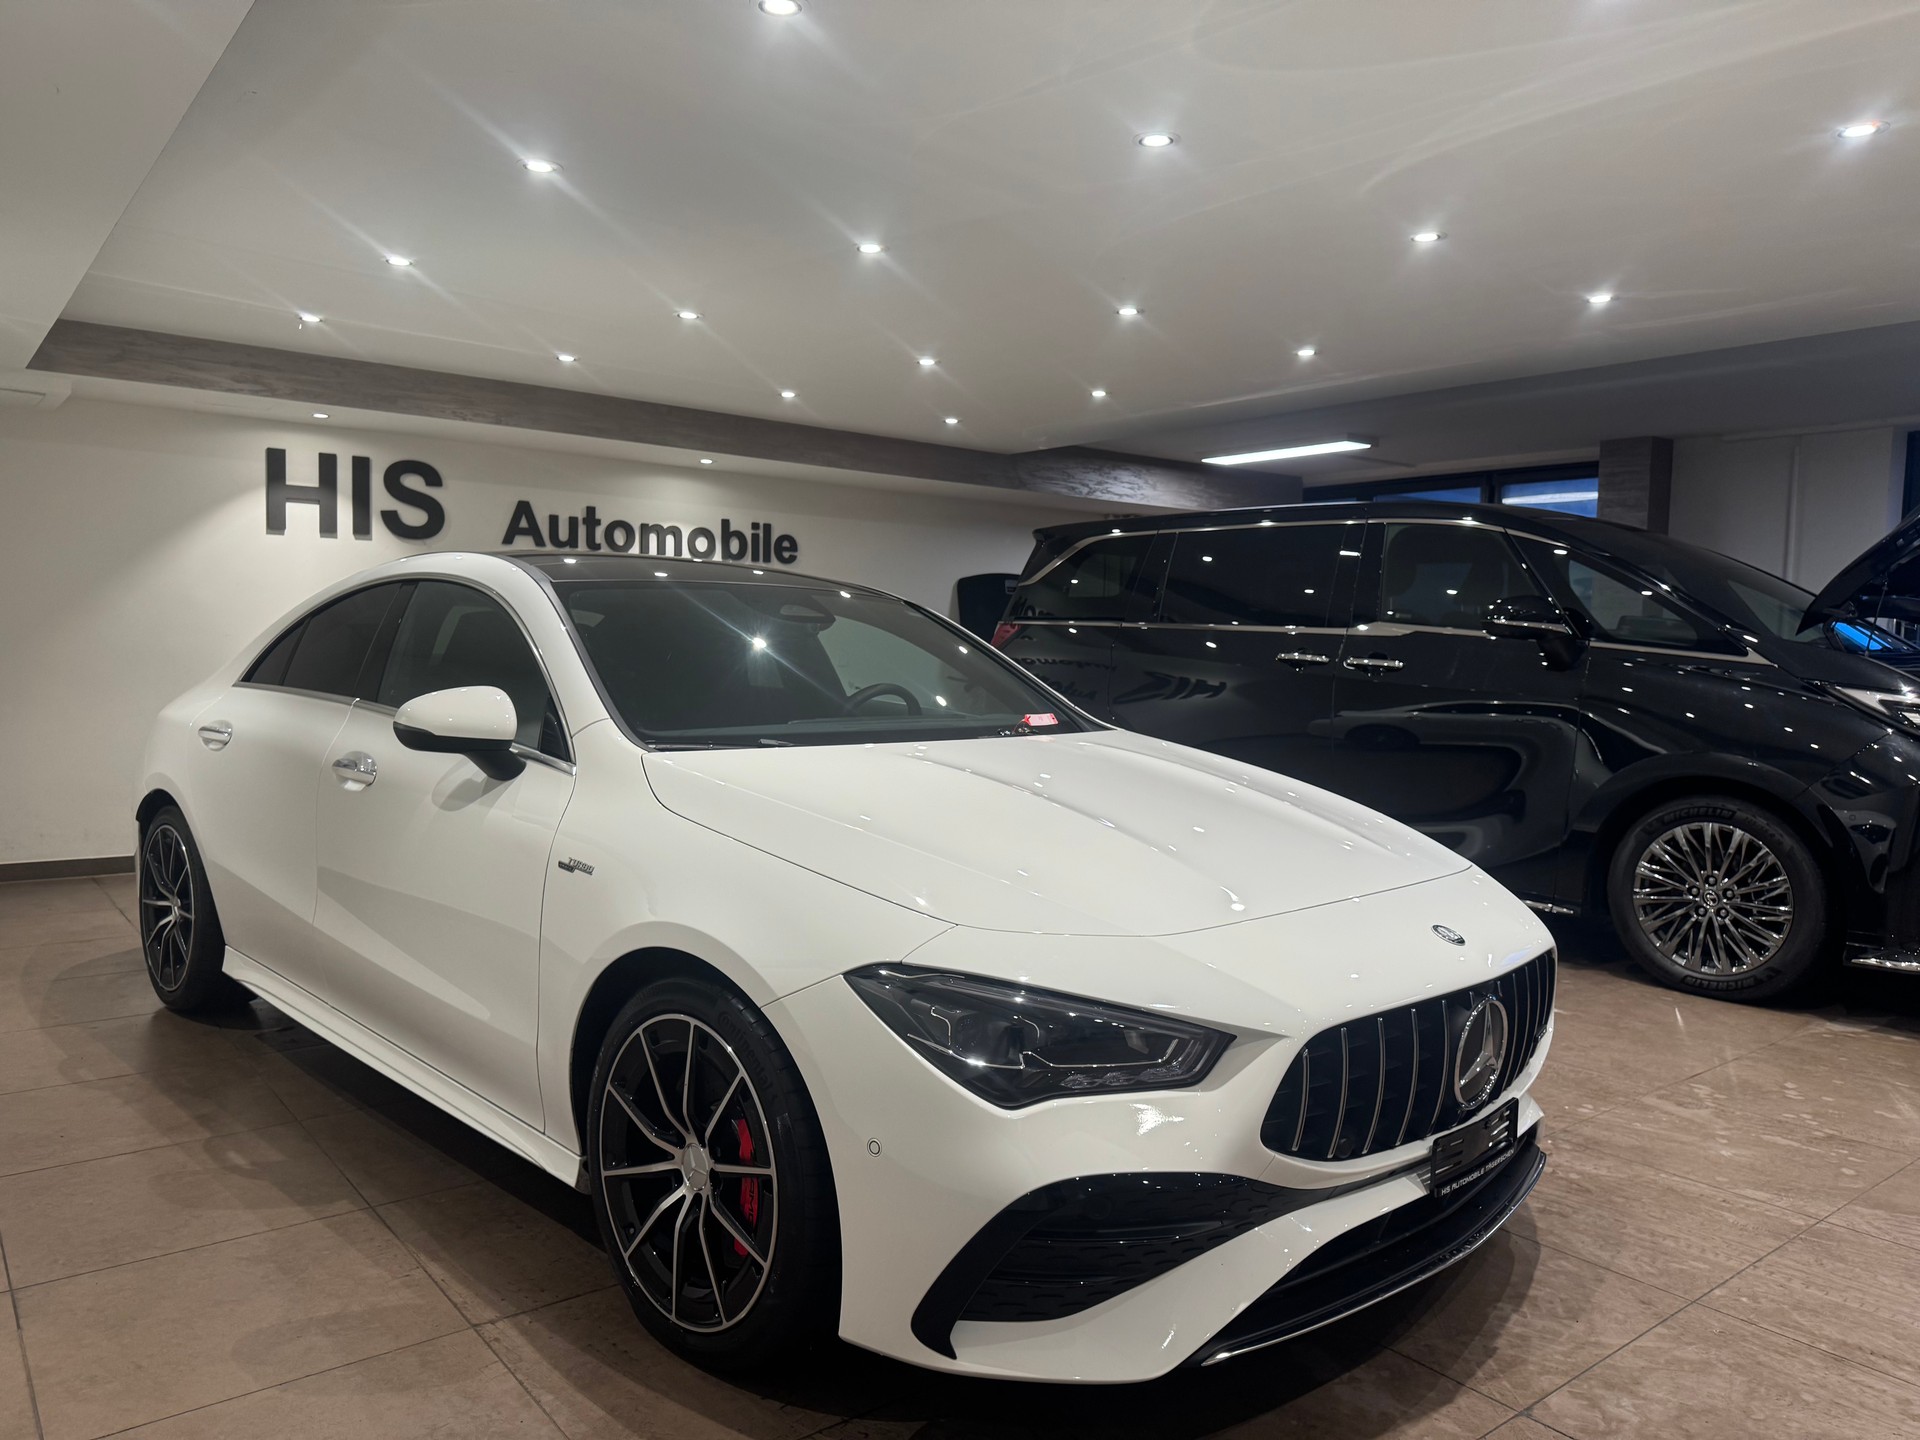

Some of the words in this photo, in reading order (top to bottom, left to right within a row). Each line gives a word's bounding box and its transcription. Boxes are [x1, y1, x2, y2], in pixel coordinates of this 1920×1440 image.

[265, 446, 446, 541] HIS
[501, 500, 799, 564] Automobile
[1662, 806, 1736, 824] MICHELIN
[717, 1010, 774, 1092] Continental
[1451, 1167, 1485, 1191] AUTOMOBILE
